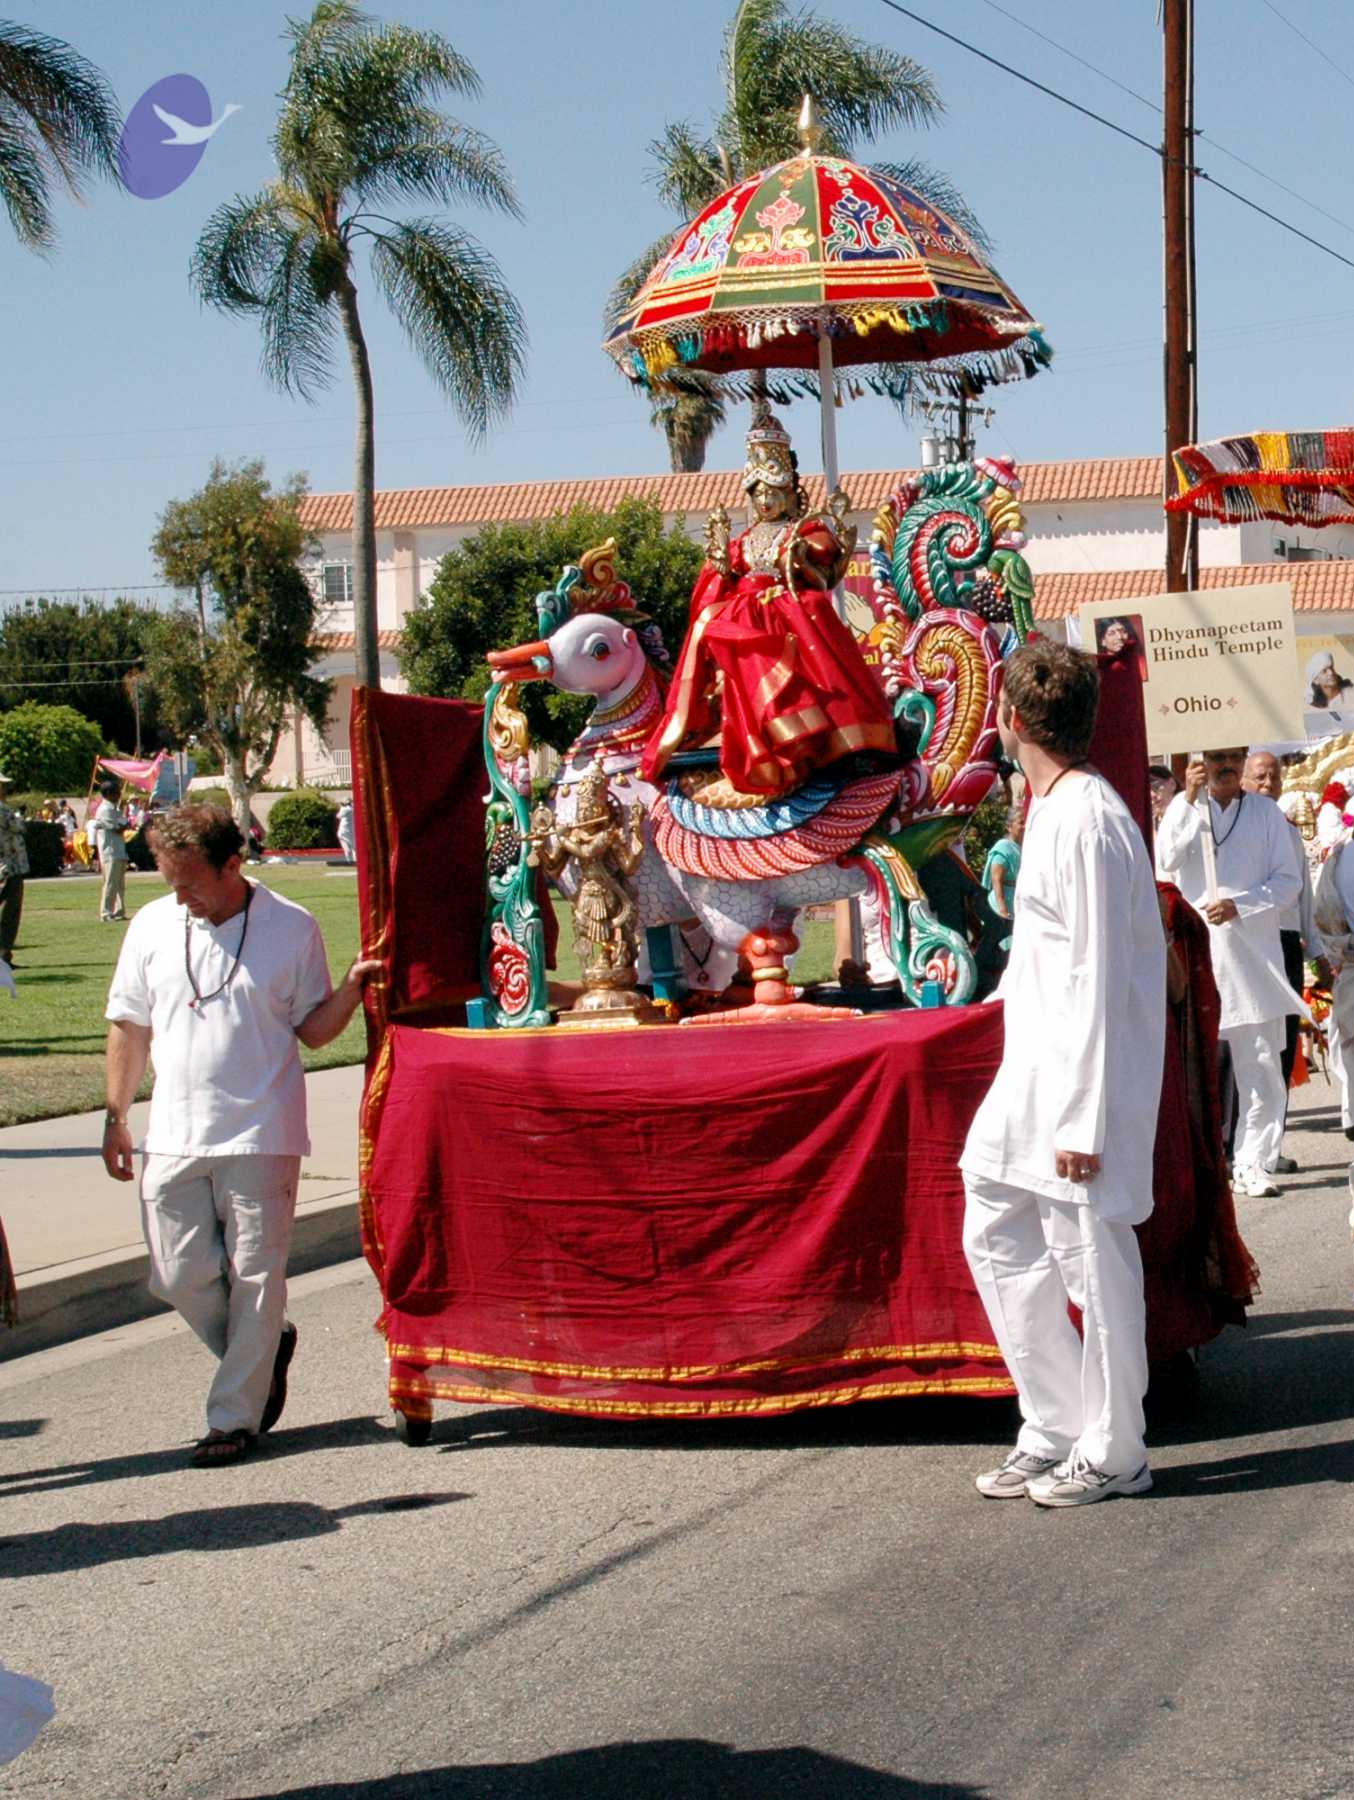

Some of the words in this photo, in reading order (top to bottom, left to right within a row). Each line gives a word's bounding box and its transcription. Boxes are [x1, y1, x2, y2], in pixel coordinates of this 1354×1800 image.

[1149, 619, 1283, 644] Dhyanapeetam
[1153, 644, 1209, 662] Hindu
[1215, 636, 1283, 655] Temple
[1174, 695, 1222, 714] Ohio
